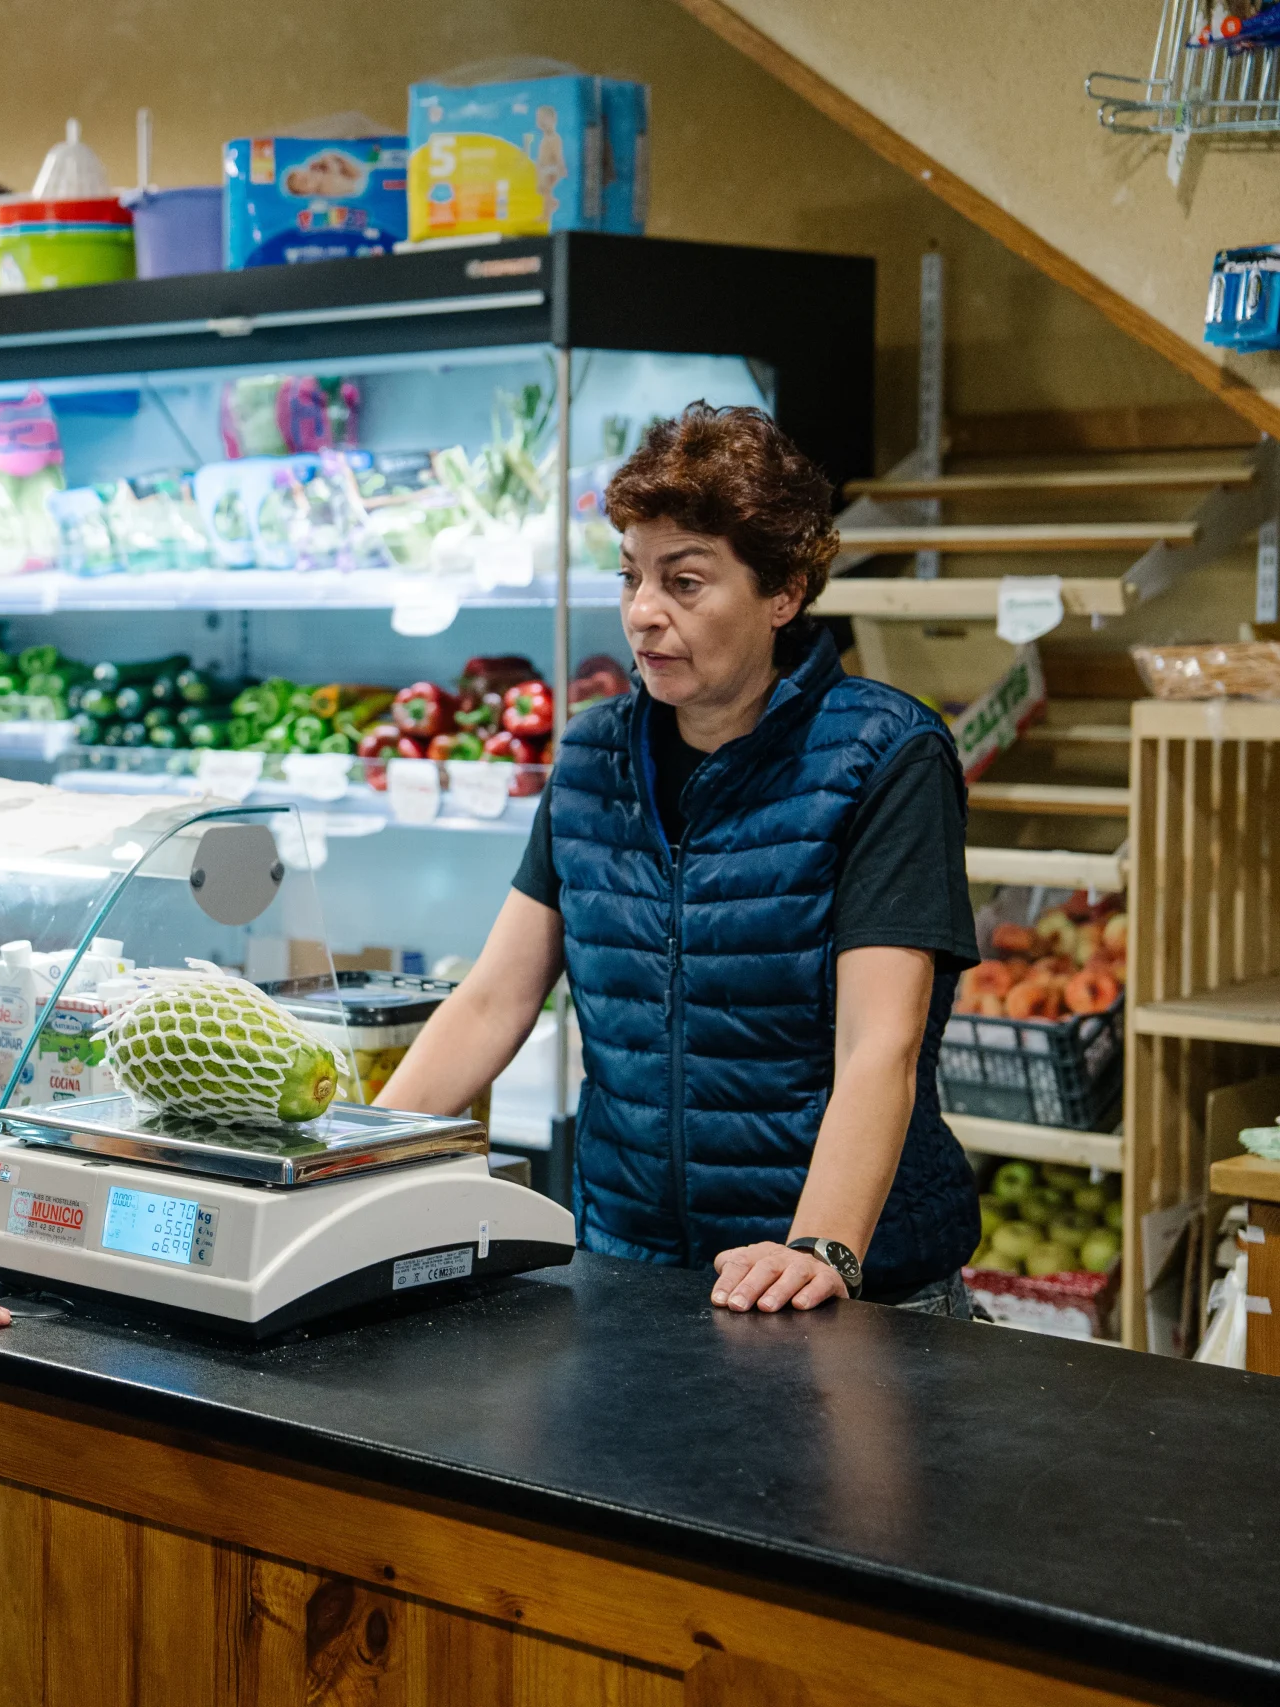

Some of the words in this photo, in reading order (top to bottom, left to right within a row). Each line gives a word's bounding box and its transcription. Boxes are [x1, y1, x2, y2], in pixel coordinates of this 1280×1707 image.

[429, 135, 457, 177] 5
[31, 1201, 84, 1226] MUNICIO
[197, 1209, 212, 1225] kg
